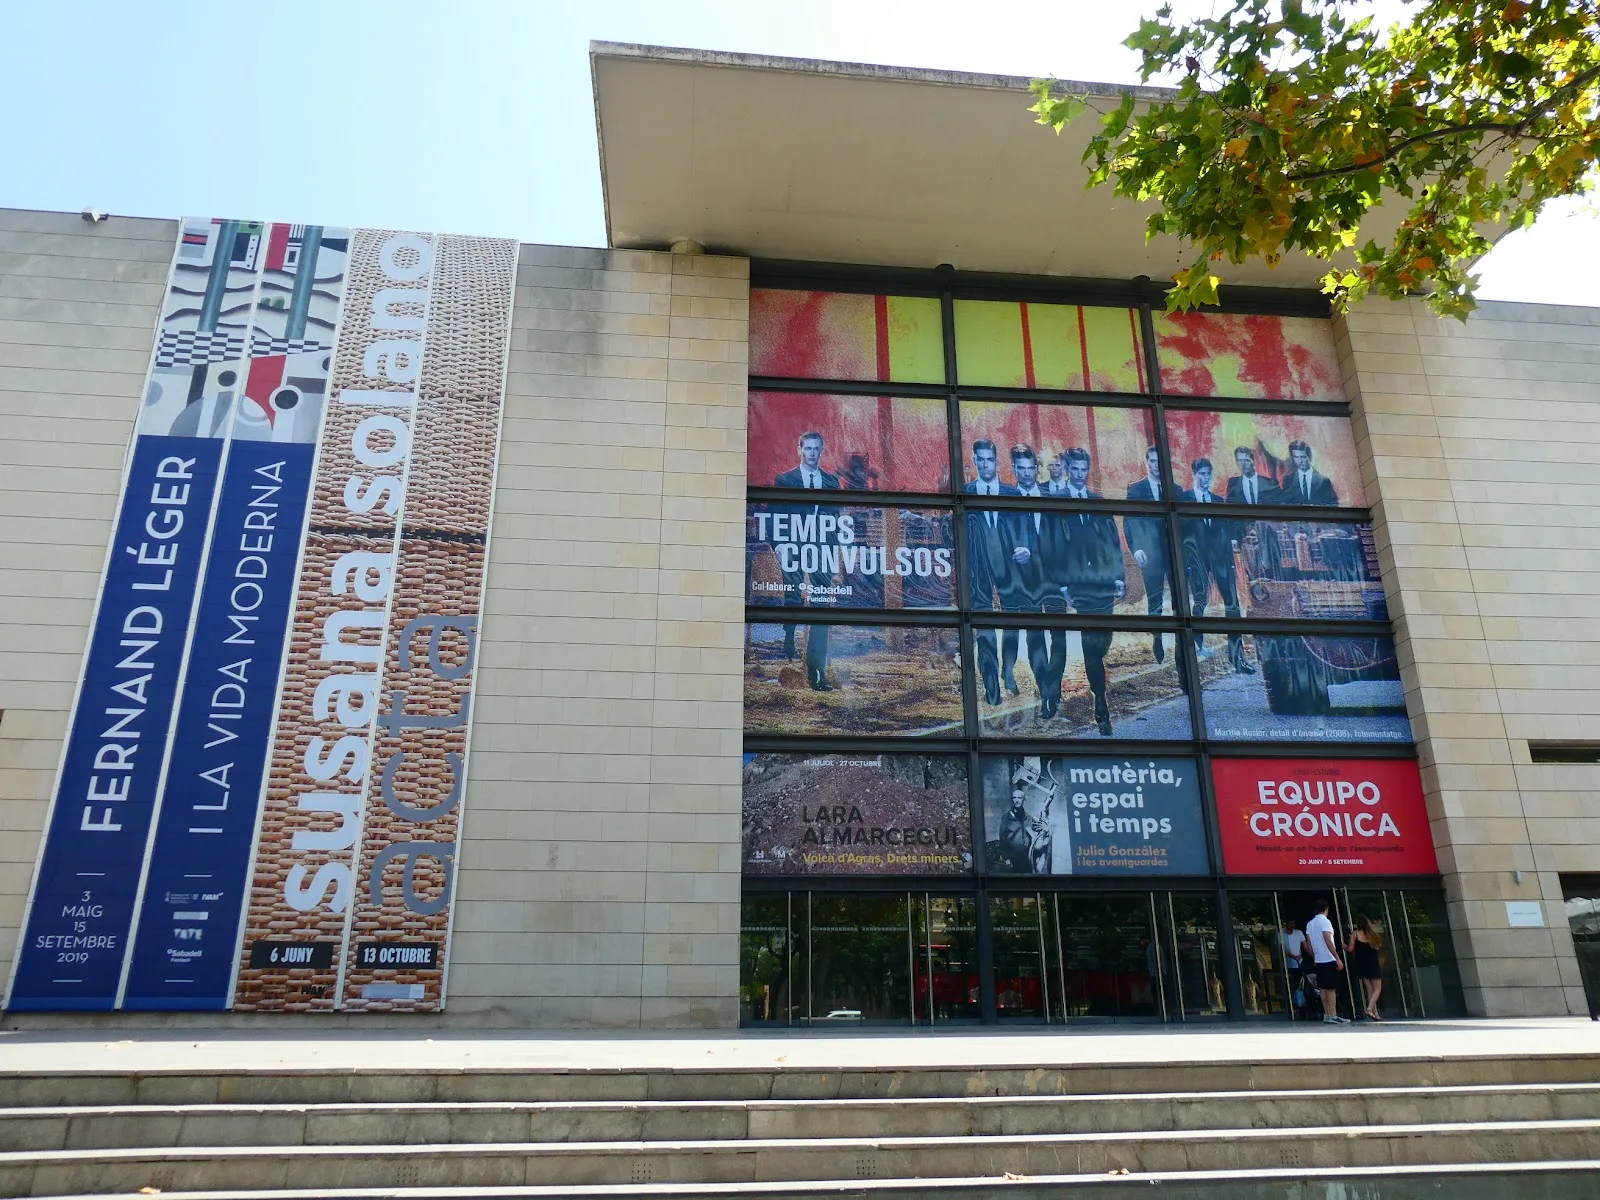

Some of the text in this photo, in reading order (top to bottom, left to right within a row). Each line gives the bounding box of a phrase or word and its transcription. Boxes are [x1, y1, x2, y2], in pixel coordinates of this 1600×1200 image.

[754, 512, 855, 544] TEMPS
[222, 461, 286, 644] MODERNA
[780, 543, 951, 577] CONVULSOS
[284, 551, 393, 914] susana
[339, 234, 432, 516] solano
[807, 584, 853, 595] Sabadell
[806, 595, 837, 603] Fundació
[80, 456, 196, 831] FERNAND LÉGER
[204, 658, 252, 749] VIDA
[370, 615, 478, 915] acta
[1070, 761, 1182, 787] matèria,
[193, 762, 234, 810] LA
[1257, 780, 1381, 806] EQUIPO
[1072, 786, 1144, 814] espai
[802, 805, 864, 823] LARA
[1250, 806, 1401, 837] CRÓNICA
[1074, 810, 1172, 839] i temps
[801, 827, 959, 846] ALMARCEGUI
[802, 852, 835, 863] Volcà
[886, 853, 918, 863] Drets
[920, 854, 959, 863] miners
[1077, 845, 1167, 856] Julio González
[1083, 857, 1097, 866] les
[1099, 857, 1169, 868] avantguardes
[81, 890, 91, 902] 3
[61, 905, 103, 917] MAIG
[74, 921, 86, 933] 15
[36, 935, 117, 948] SETEMBRE
[57, 952, 89, 964] 2019
[171, 949, 203, 957] Sabadell
[270, 947, 314, 963] 6 JUNY
[363, 947, 432, 963] 13 OCTUBRE
